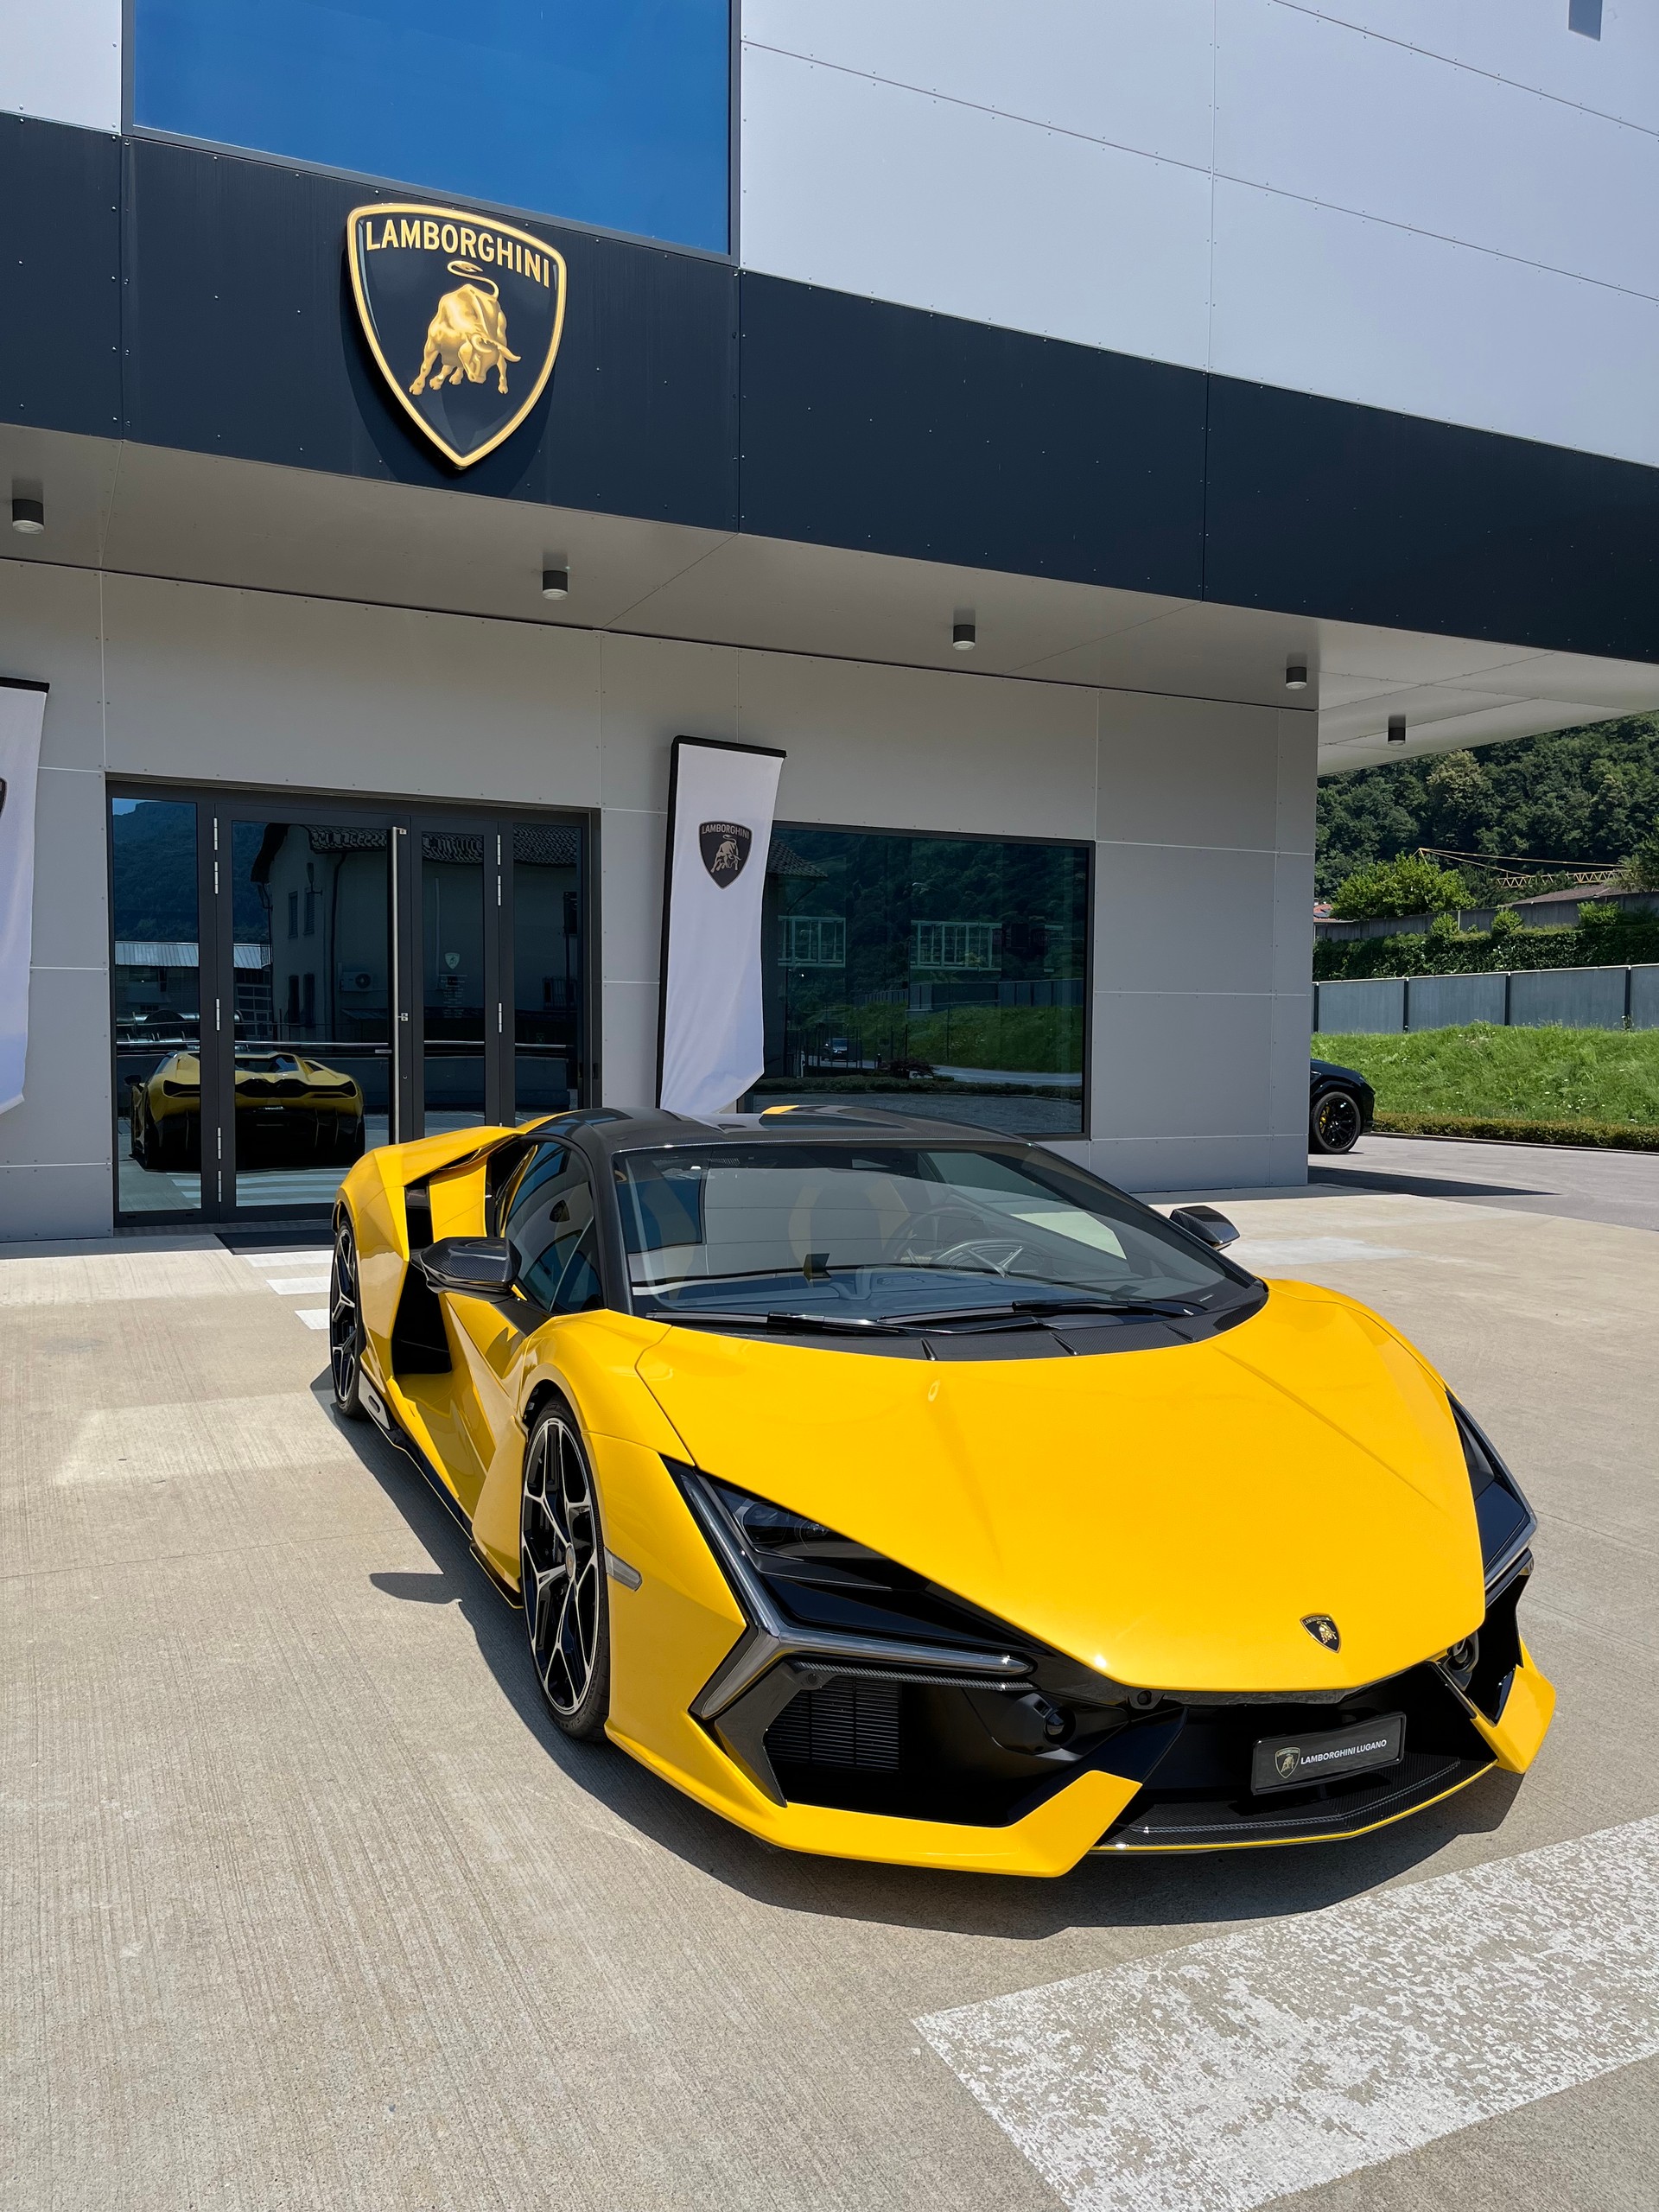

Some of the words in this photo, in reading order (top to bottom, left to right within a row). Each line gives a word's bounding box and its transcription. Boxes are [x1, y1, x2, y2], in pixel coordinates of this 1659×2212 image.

[365, 219, 550, 289] LAMBORGHINI
[702, 823, 750, 840] LAMBORGHINI
[1300, 1746, 1356, 1765] LAMBORGHINI
[1356, 1738, 1387, 1754] LUGANO
